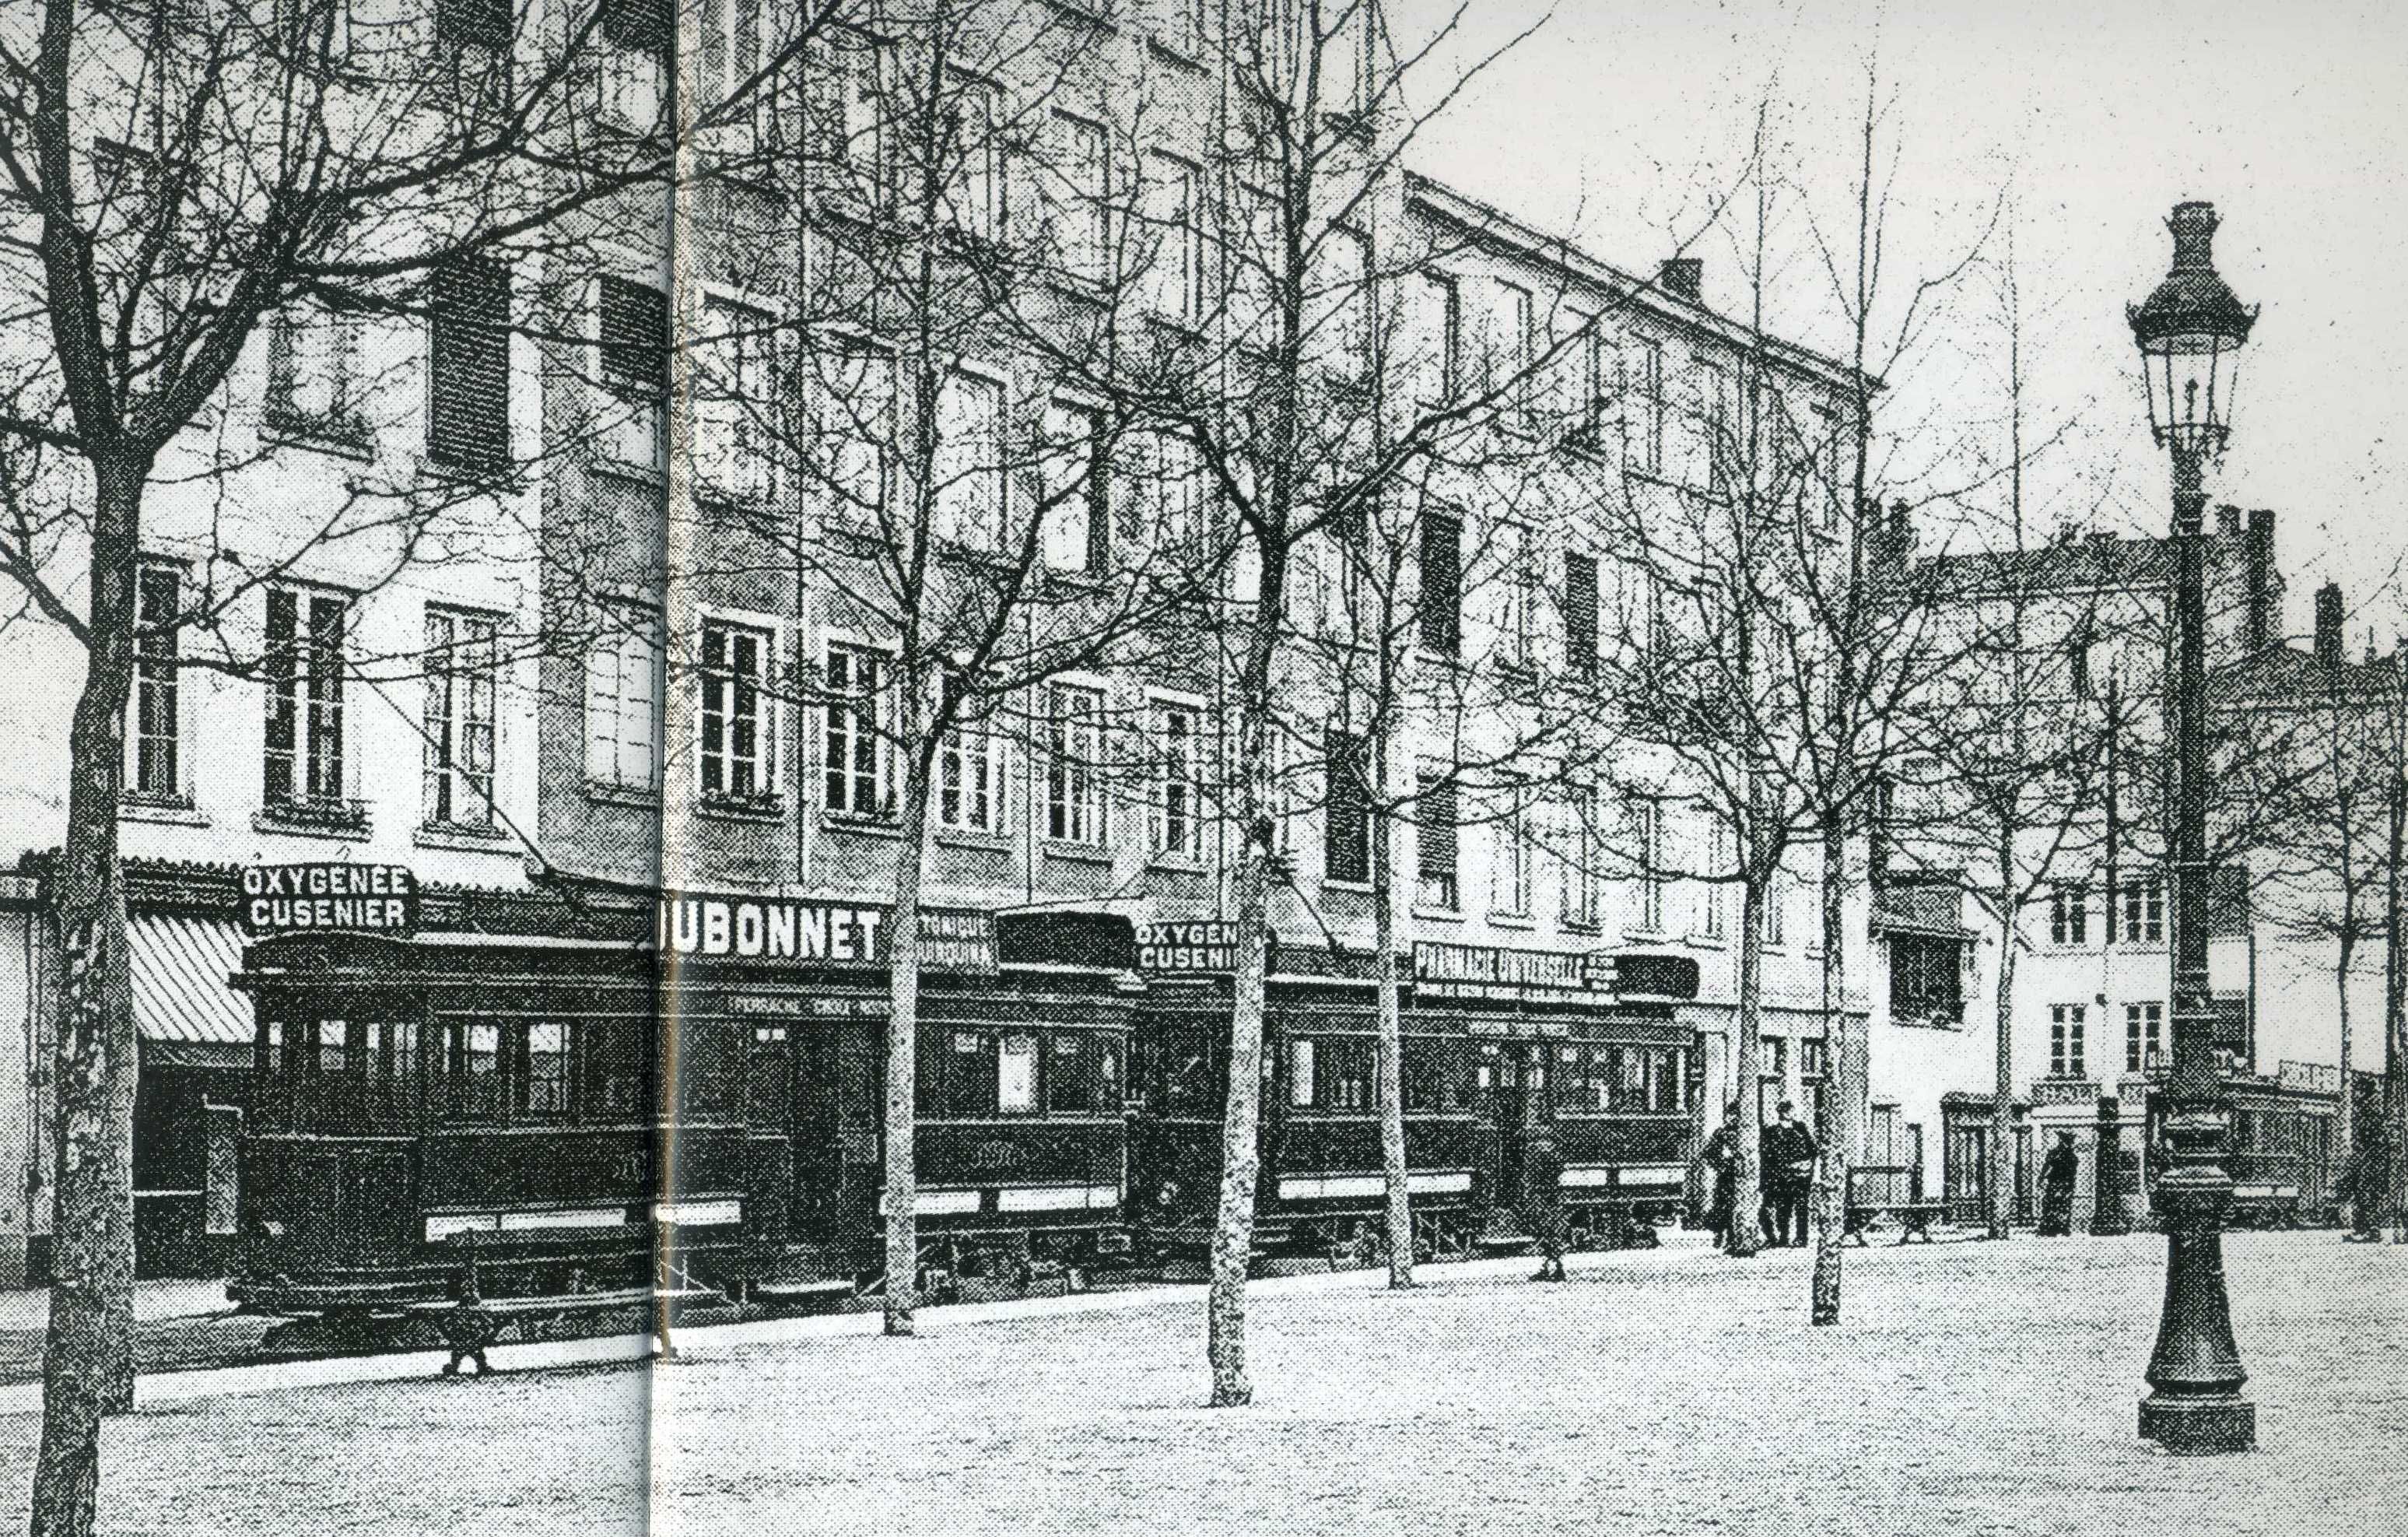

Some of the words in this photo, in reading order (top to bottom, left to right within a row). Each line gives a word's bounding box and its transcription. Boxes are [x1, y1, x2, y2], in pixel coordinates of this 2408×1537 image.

[251, 899, 406, 928] CUSENIER
[1135, 923, 1239, 945] OXYGEN
[1140, 946, 1239, 968] CUSENI
[1415, 942, 1496, 983] PHARMACIE
